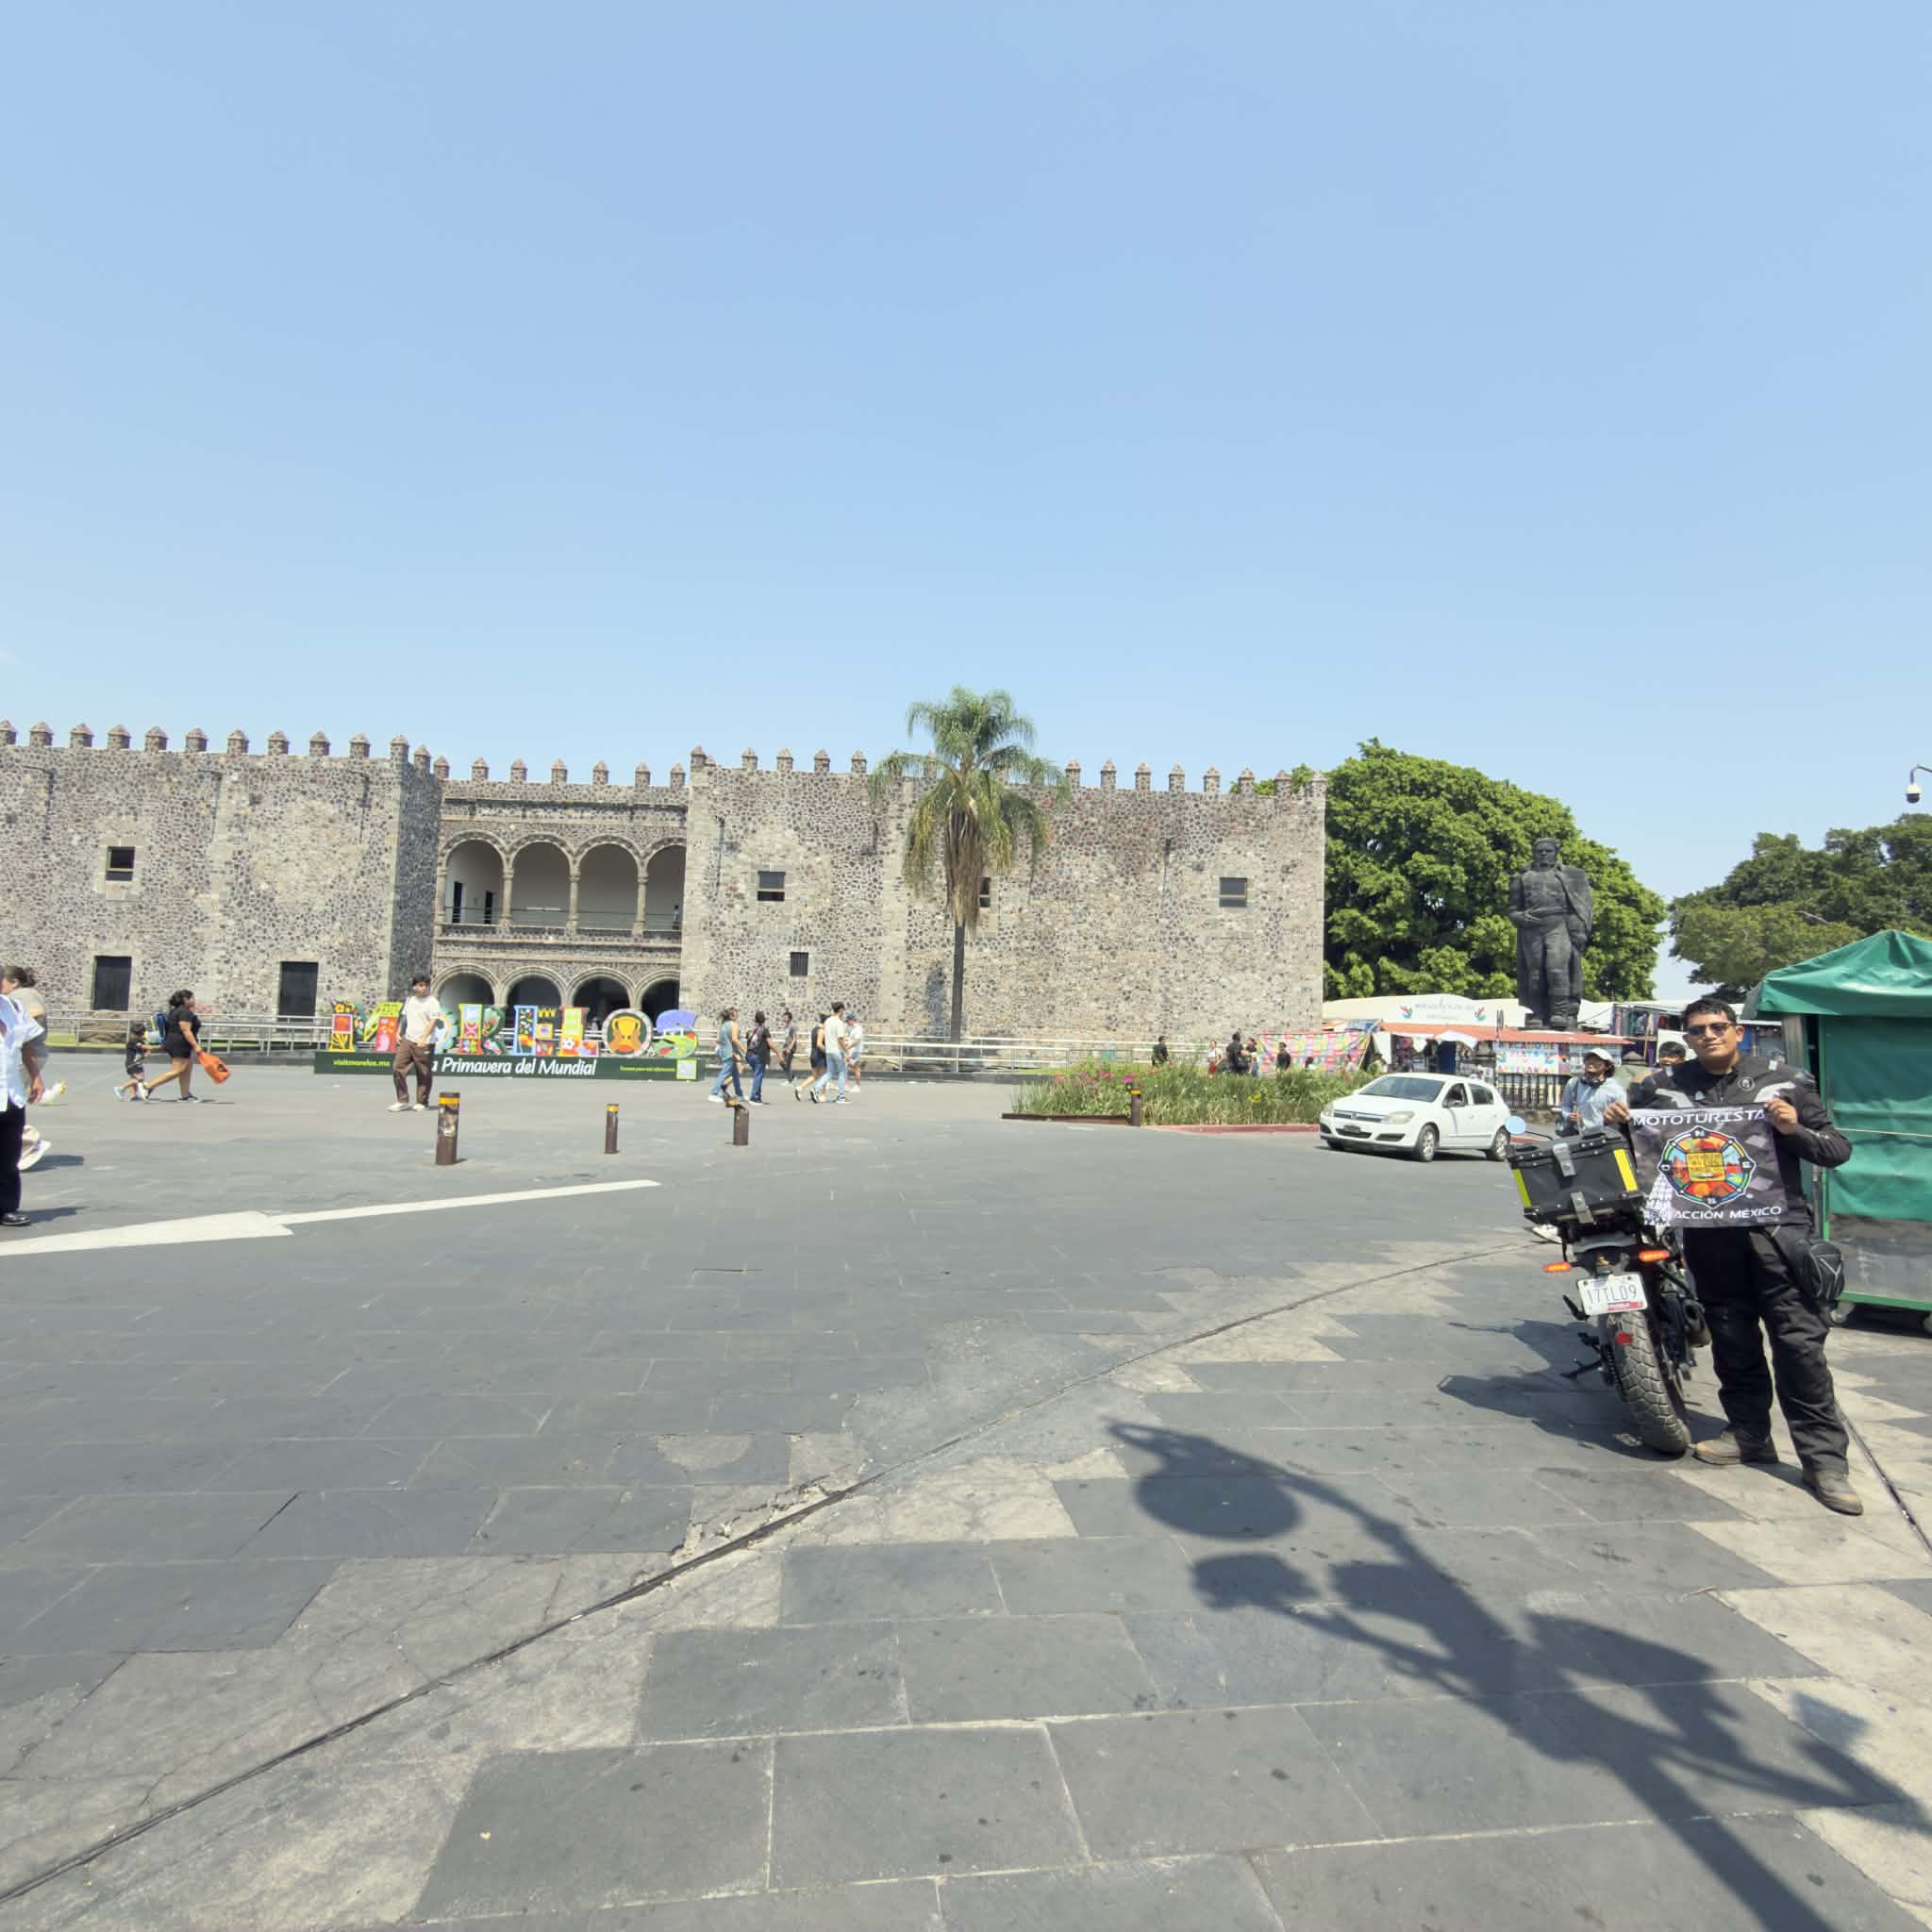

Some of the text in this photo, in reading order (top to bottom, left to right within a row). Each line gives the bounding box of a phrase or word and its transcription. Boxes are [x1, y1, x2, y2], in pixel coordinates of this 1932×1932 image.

[441, 1057, 511, 1074] Primavera
[515, 1058, 535, 1075] del
[538, 1058, 597, 1076] Mundial
[1634, 1109, 1766, 1125] MOTOTURISTA
[1674, 1208, 1724, 1221] ACCIÓN
